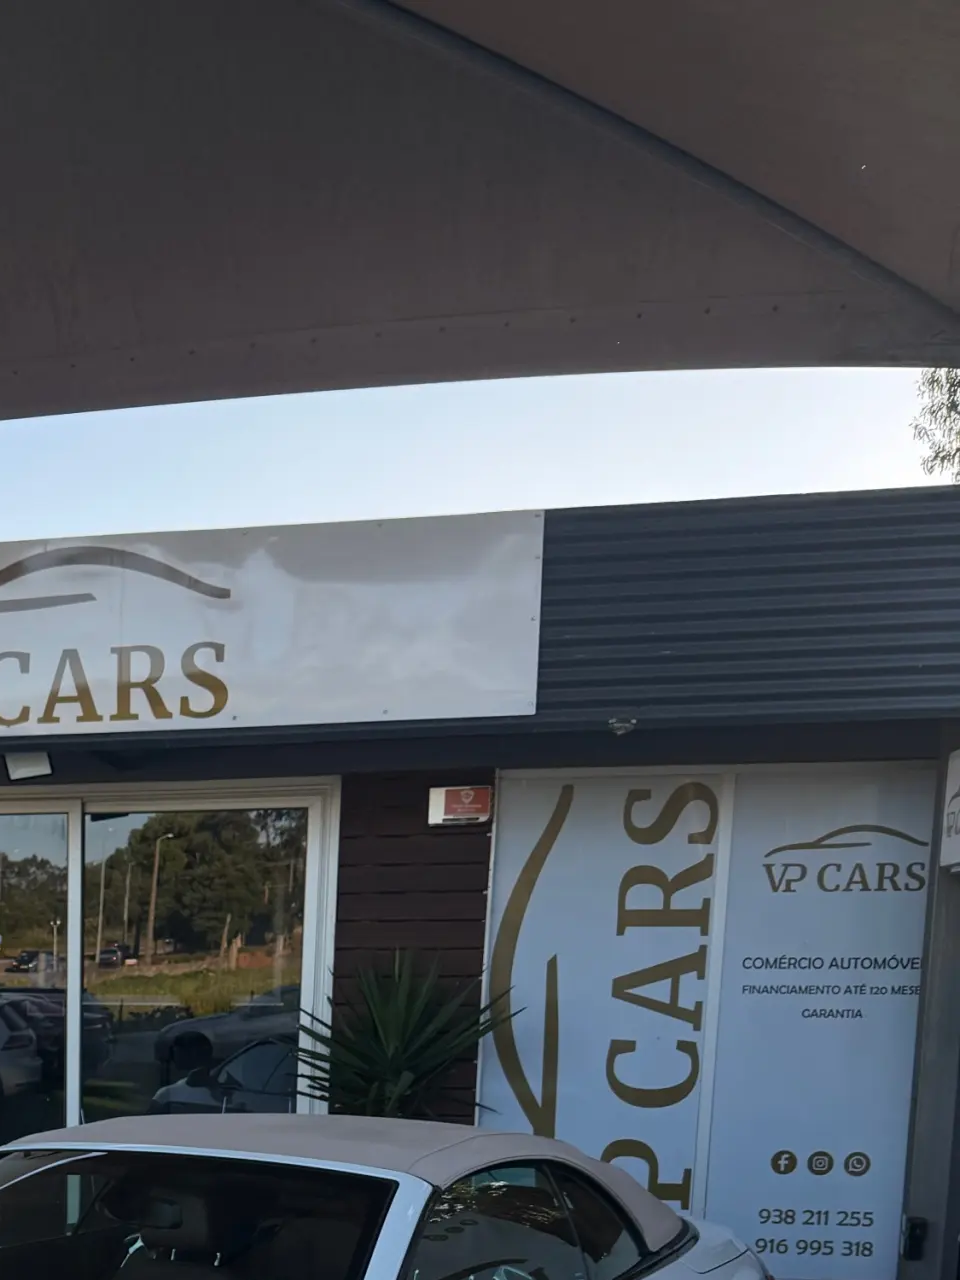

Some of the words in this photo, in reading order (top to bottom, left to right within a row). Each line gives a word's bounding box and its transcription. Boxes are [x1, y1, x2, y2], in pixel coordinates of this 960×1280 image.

[762, 863, 808, 893] VP
[816, 862, 927, 893] CARS
[606, 781, 720, 1109] CARS
[742, 954, 825, 970] COMÉRCIO
[828, 954, 921, 970] AUTOMÓVE
[742, 984, 840, 996] FINANCIAMENTO
[843, 983, 867, 996] ATÉ
[869, 986, 888, 996] 120
[890, 985, 920, 996] MESE
[801, 1008, 864, 1019] GARANTIA
[758, 1208, 796, 1225] 938
[802, 1209, 829, 1226] 211
[836, 1211, 874, 1227] 255
[755, 1238, 788, 1254] 916
[795, 1239, 834, 1256] 995
[841, 1240, 874, 1257] 318
